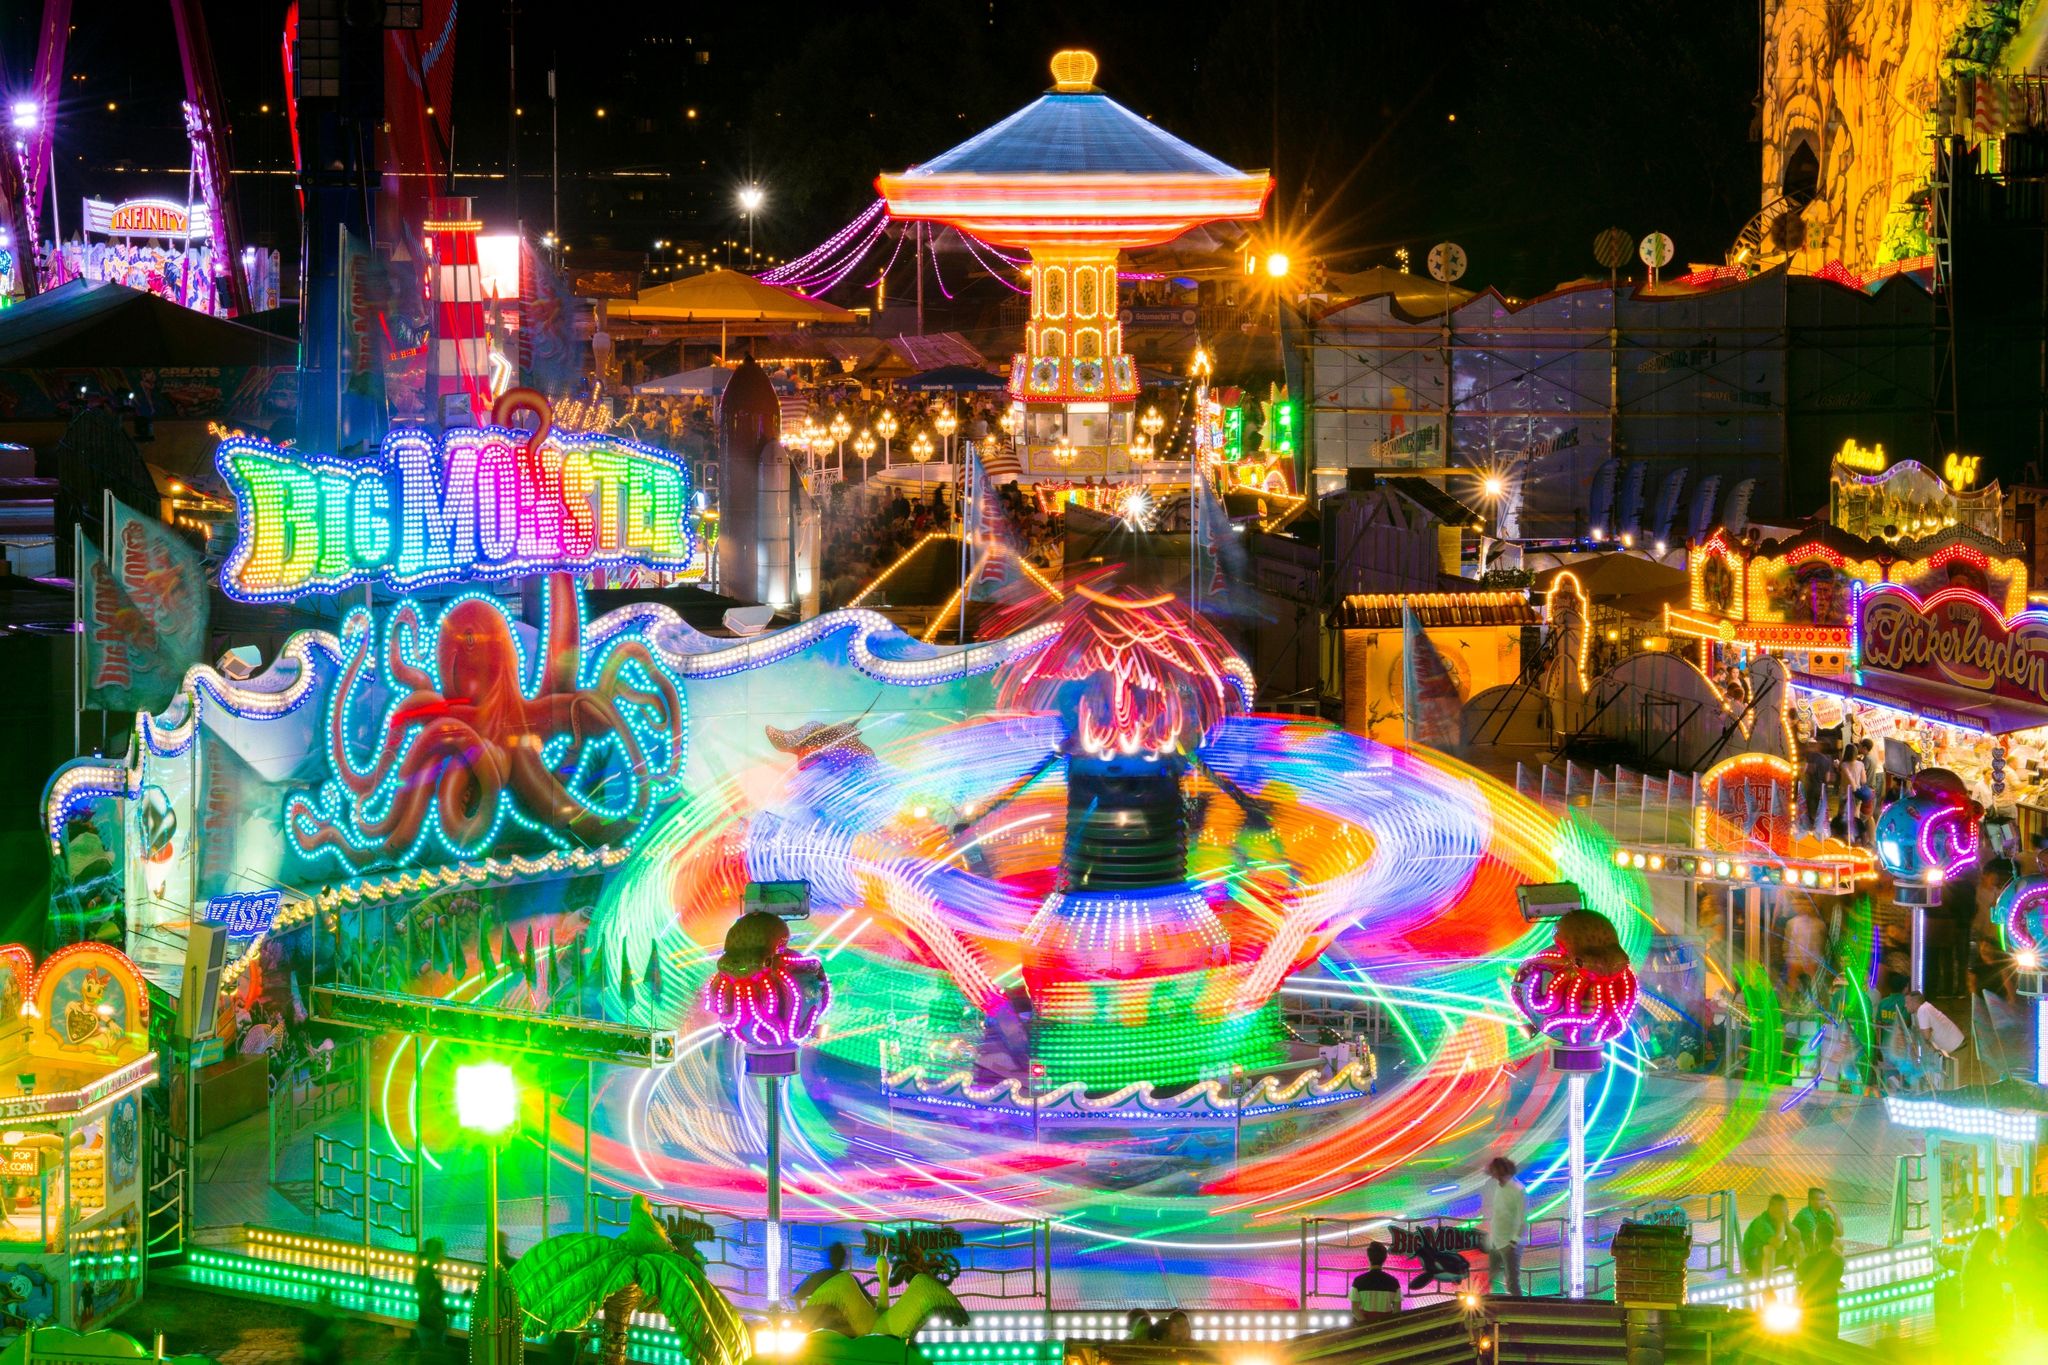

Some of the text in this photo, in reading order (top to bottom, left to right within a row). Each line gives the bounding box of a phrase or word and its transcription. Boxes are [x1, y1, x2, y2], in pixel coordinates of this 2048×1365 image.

[115, 207, 186, 233] INFINITY
[236, 443, 690, 588] BIG MONSTER
[93, 644, 133, 690] BIG
[211, 898, 277, 931] KASSE
[10, 1162, 35, 1173] CORN
[13, 1151, 32, 1161] POP
[896, 1227, 964, 1255] MONSTER
[1389, 1226, 1421, 1254] BIG
